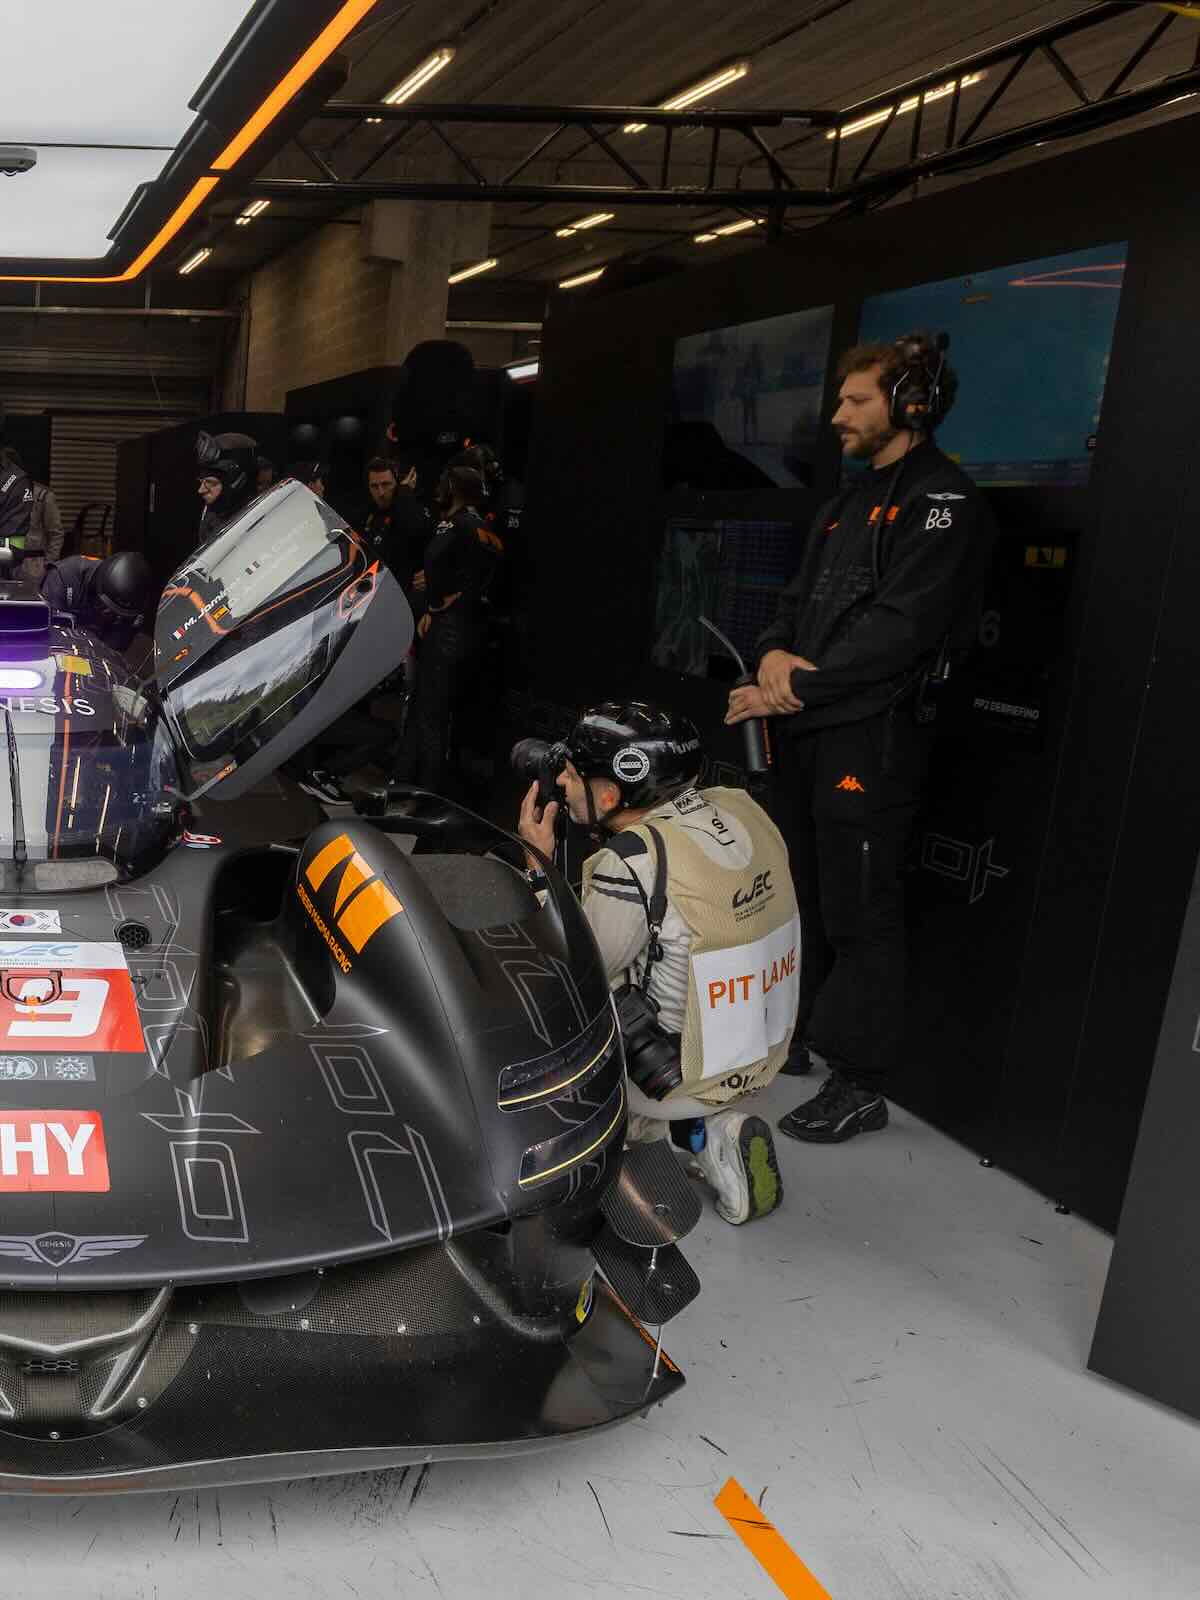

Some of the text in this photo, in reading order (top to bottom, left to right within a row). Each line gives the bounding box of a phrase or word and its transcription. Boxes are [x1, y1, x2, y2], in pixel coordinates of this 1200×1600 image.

[732, 870, 776, 909] WEC
[707, 945, 797, 1009] PIT LANE
[0, 1122, 98, 1176] HY
